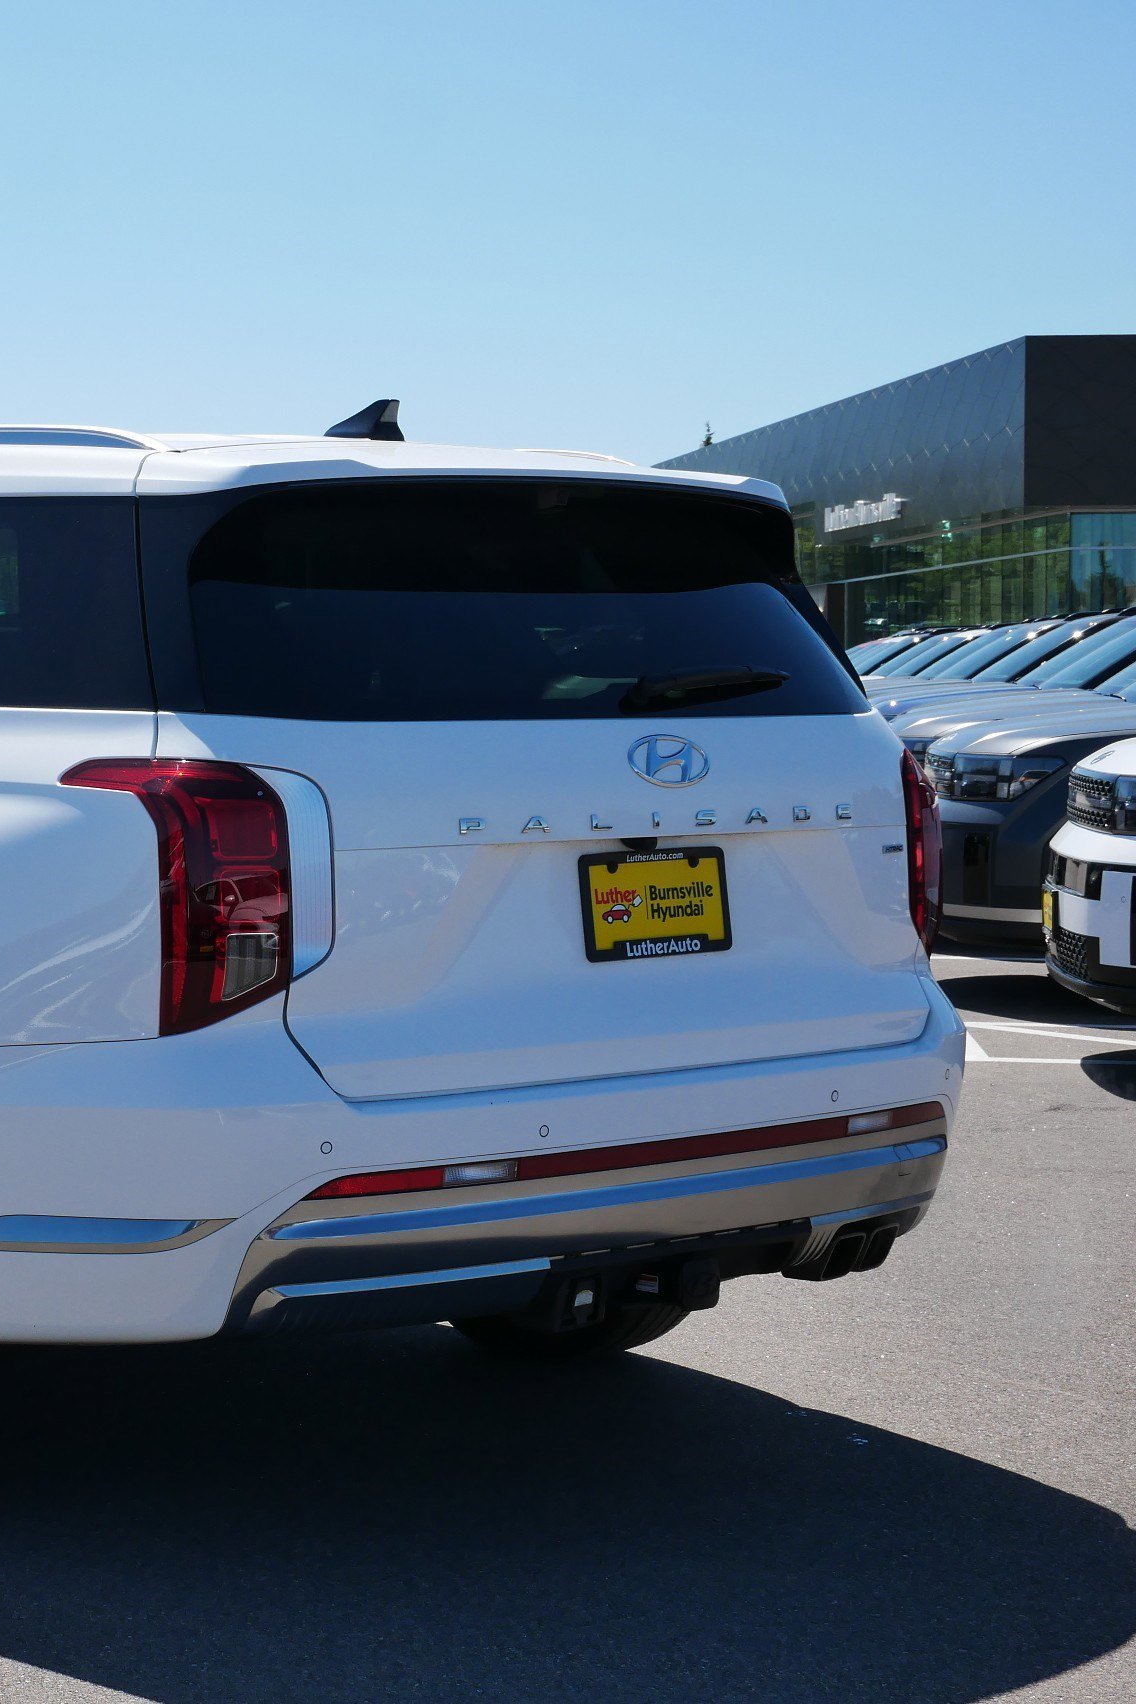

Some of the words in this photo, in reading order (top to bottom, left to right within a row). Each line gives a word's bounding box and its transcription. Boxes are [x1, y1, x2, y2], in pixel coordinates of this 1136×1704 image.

[459, 803, 853, 835] PALISADE
[626, 852, 684, 863] LutherAuto.com
[594, 886, 637, 905] Luther
[649, 882, 714, 901] Burnsville
[650, 900, 704, 923] Hyundai
[626, 938, 701, 957] LutherAuto
